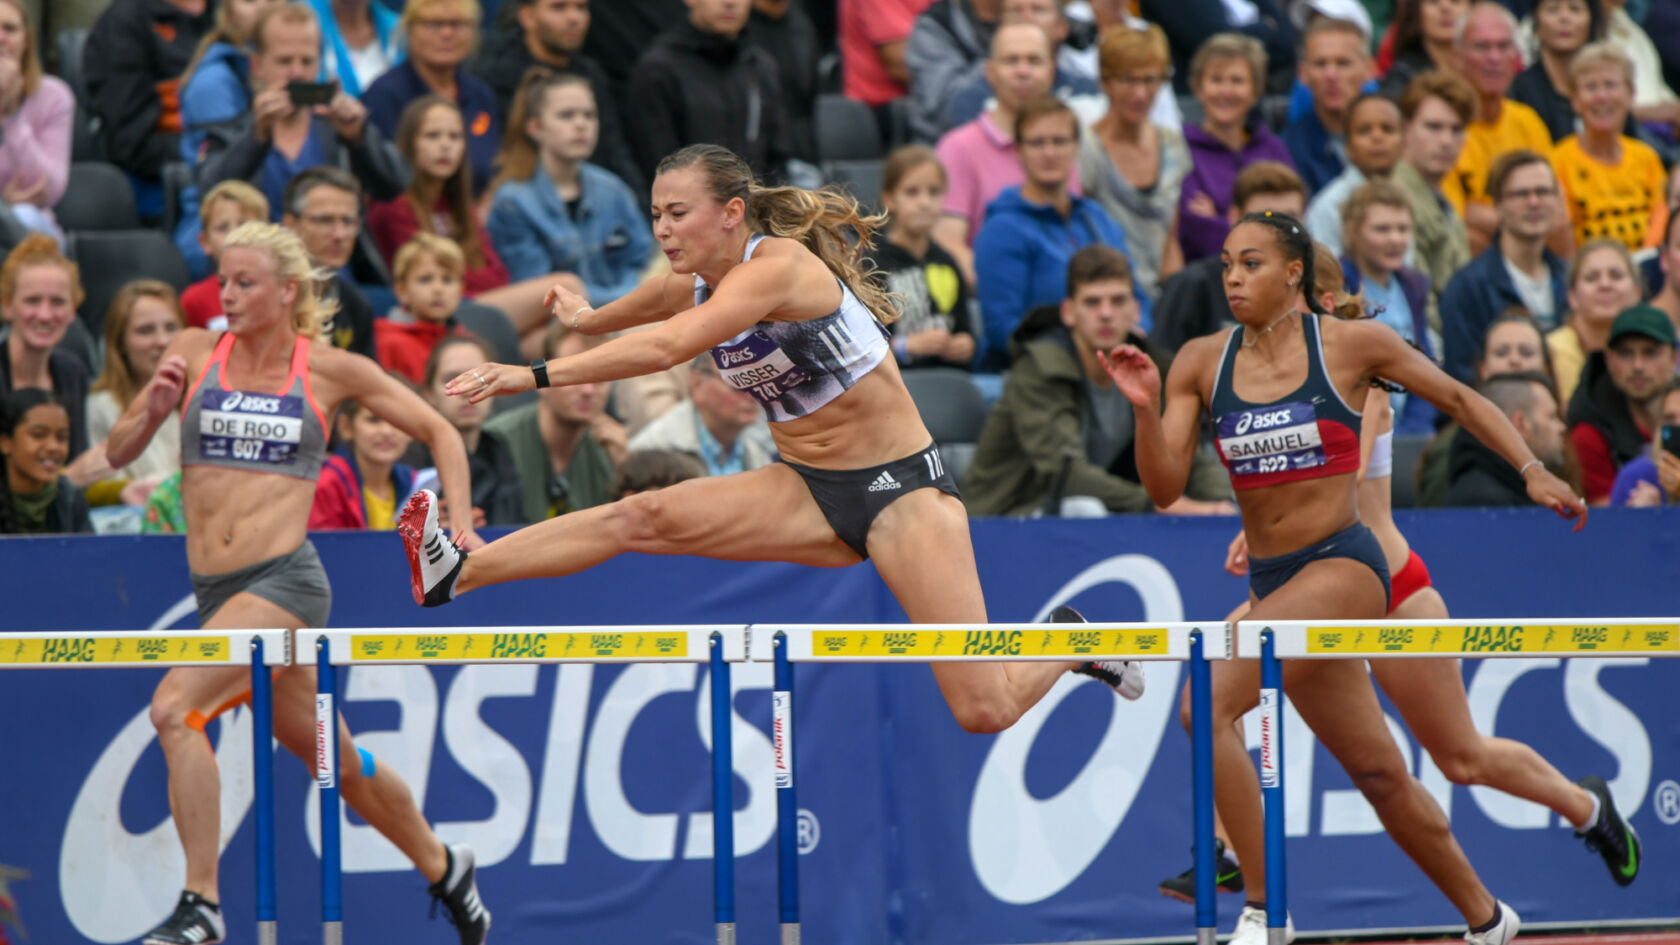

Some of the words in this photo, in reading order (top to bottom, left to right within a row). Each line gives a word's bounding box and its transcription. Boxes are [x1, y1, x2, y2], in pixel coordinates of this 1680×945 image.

[728, 363, 780, 388] VISSER
[753, 381, 783, 401] 747
[240, 396, 281, 413] asics
[212, 418, 238, 434] DE
[244, 421, 287, 439] ROO
[1253, 409, 1291, 429] asics
[232, 439, 264, 460] 607
[1229, 433, 1310, 458] SAMUEL
[1259, 455, 1288, 474] 622
[868, 481, 902, 492] adidas
[41, 638, 96, 662] HAAG
[136, 639, 168, 653] HAAG
[415, 636, 448, 650] HAAG
[491, 633, 547, 657] HAAG
[590, 634, 623, 648] HAAG
[882, 633, 917, 647] HAAG
[963, 631, 1022, 655] HAAG
[1067, 632, 1101, 645] HAAG
[1378, 629, 1414, 644] HAAG
[1461, 626, 1523, 651] HAAG
[1572, 627, 1608, 642] HAAG
[317, 720, 328, 770] polanik
[773, 717, 786, 770] polanik
[1262, 716, 1273, 770] polanik
